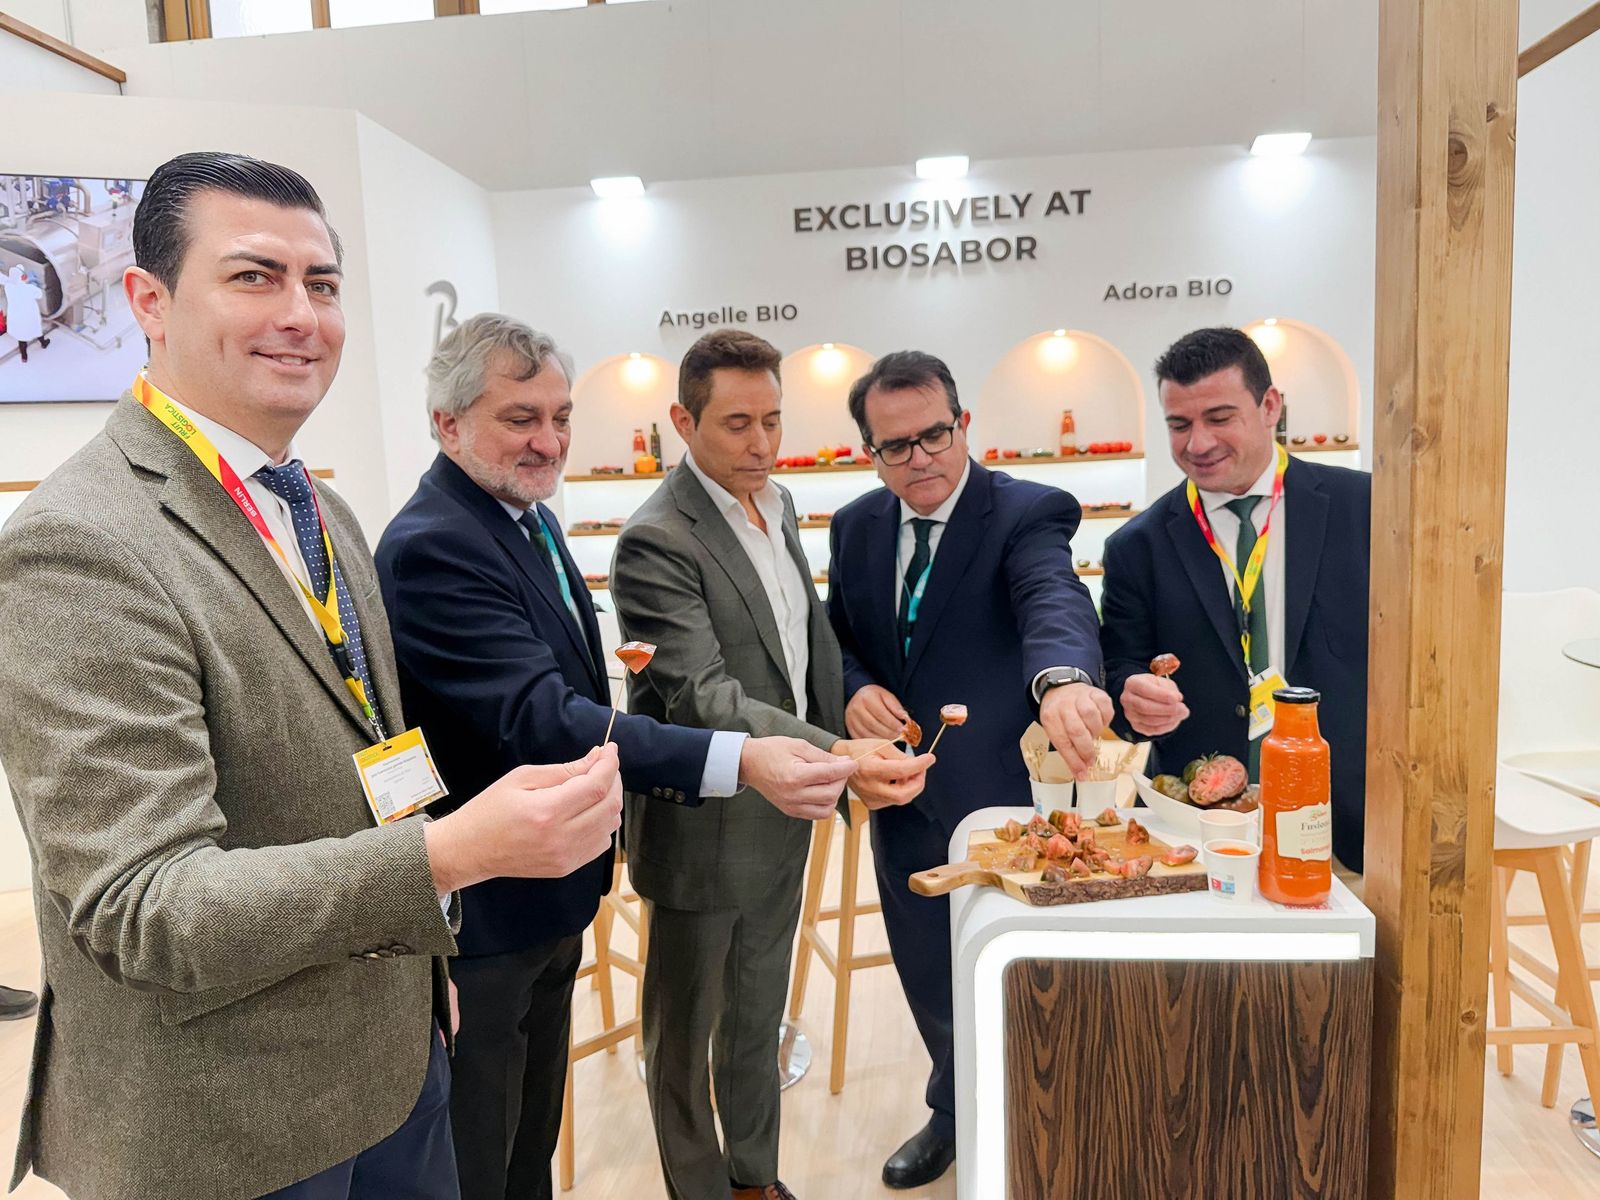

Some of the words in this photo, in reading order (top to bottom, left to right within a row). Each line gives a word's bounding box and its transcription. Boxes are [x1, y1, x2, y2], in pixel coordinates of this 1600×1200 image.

[793, 192, 1033, 233] EXCLUSIVELY
[1044, 189, 1092, 218] AT
[846, 235, 1038, 271] BIOSABOR
[1103, 281, 1178, 302] Adora
[1187, 279, 1233, 297] BIO
[659, 306, 748, 329] Angelle
[756, 304, 798, 322] BIO
[164, 403, 197, 436] LOGISTICA
[171, 421, 192, 440] FRUIT
[233, 486, 258, 518] BERLIN
